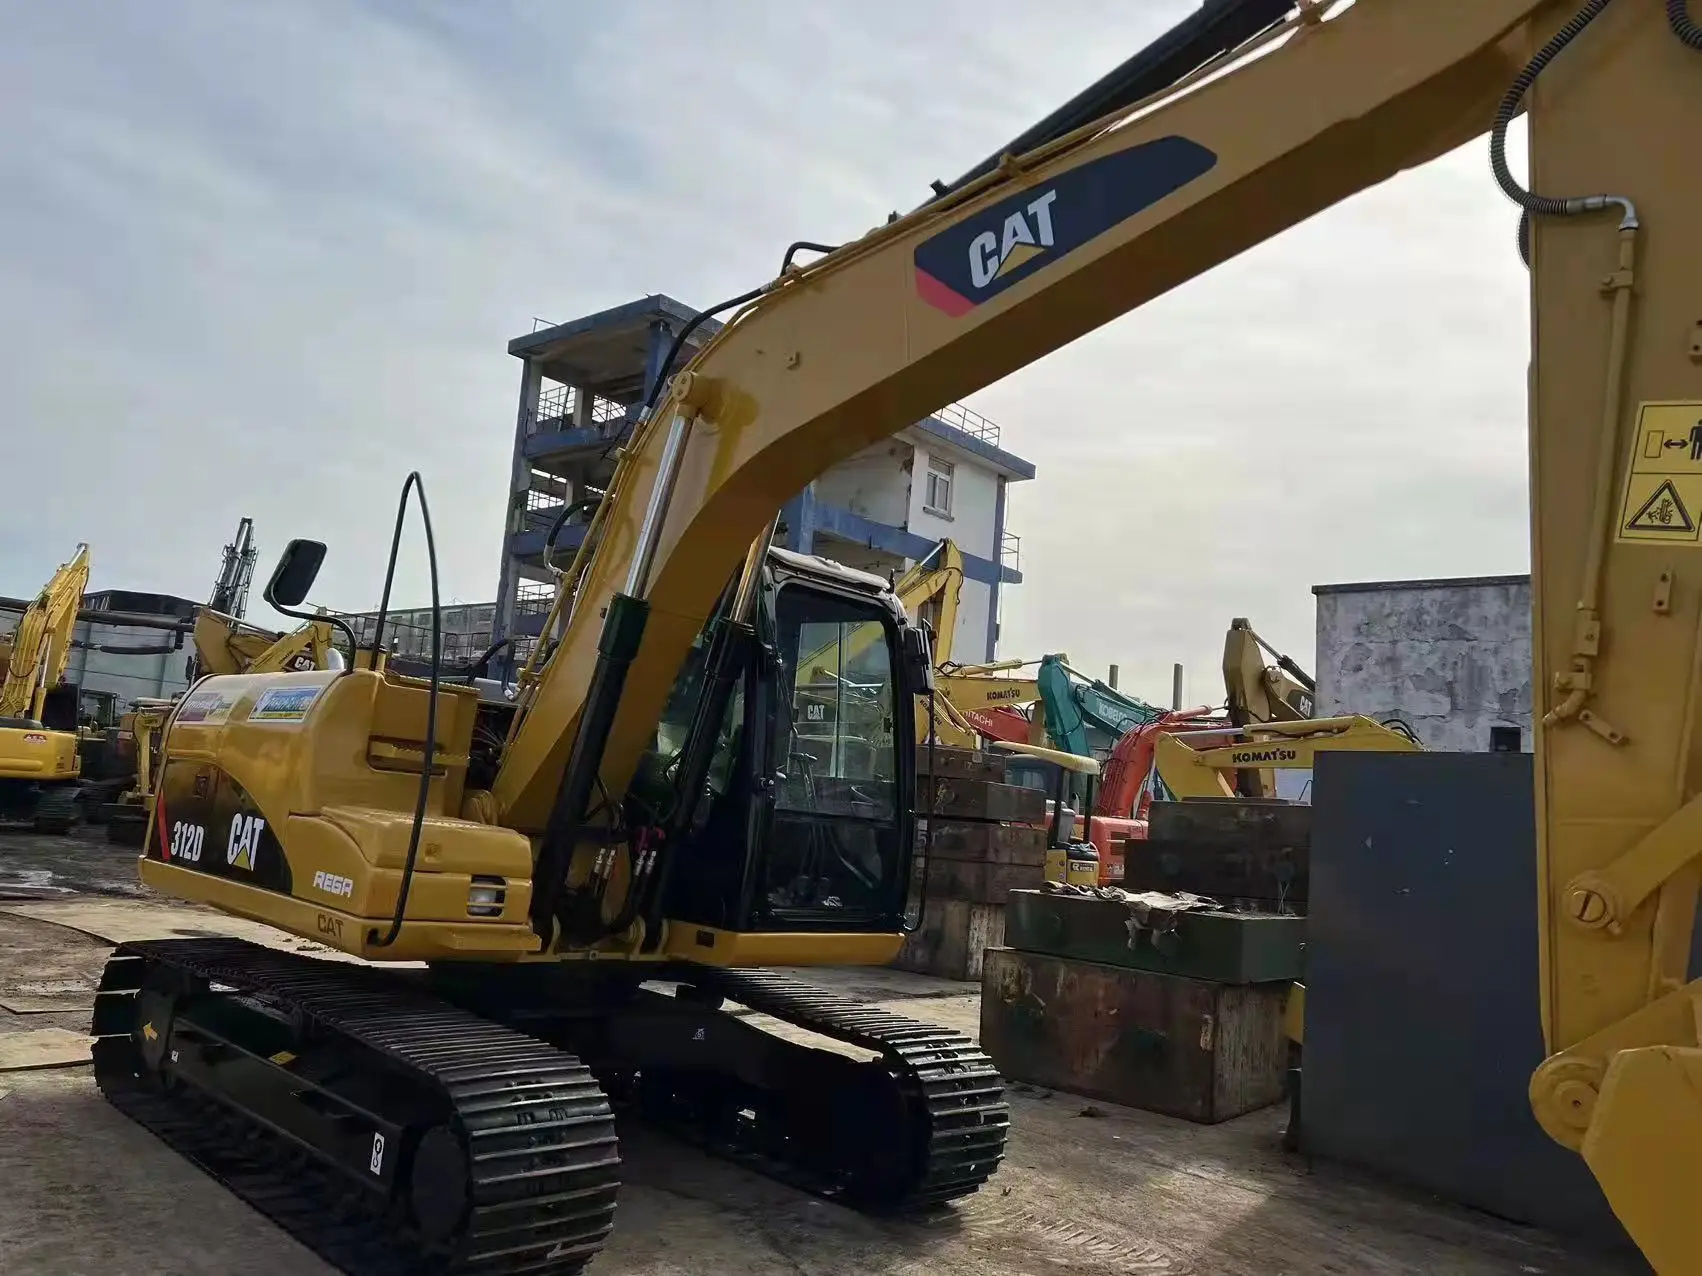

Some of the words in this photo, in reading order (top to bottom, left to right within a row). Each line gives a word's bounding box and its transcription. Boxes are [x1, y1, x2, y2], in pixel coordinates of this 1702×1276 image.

[969, 189, 1057, 288] CAT
[294, 656, 316, 671] CAT
[986, 688, 1021, 700] KOMATSU
[807, 704, 825, 720] CAT
[1299, 695, 1313, 718] CAT
[1232, 748, 1296, 763] KOMATSU
[170, 820, 205, 862] 312D
[226, 812, 265, 872] CAT
[317, 914, 344, 938] CAT
